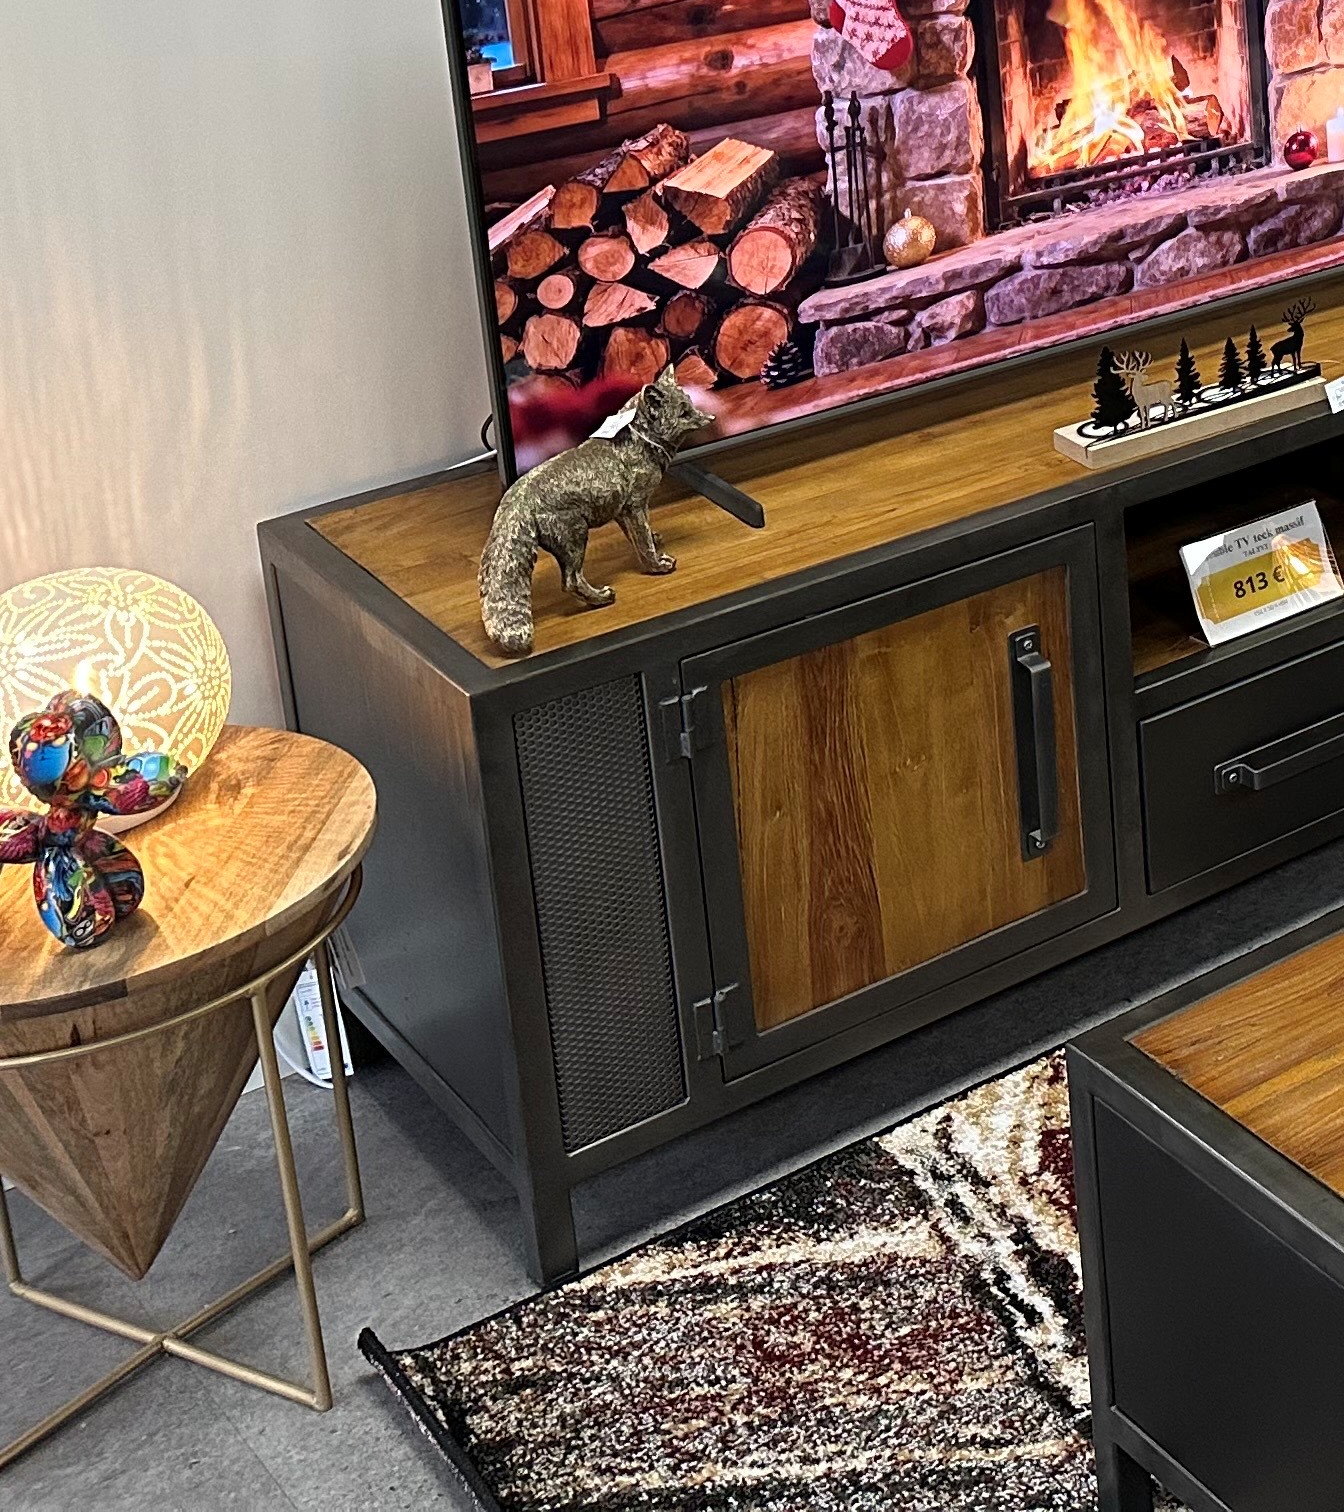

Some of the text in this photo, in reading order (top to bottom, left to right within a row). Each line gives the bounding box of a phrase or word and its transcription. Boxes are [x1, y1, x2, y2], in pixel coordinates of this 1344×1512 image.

[1234, 535, 1250, 550] TV
[1253, 527, 1274, 543] teck
[1274, 515, 1305, 535] massif
[1234, 565, 1286, 599] 813 €
